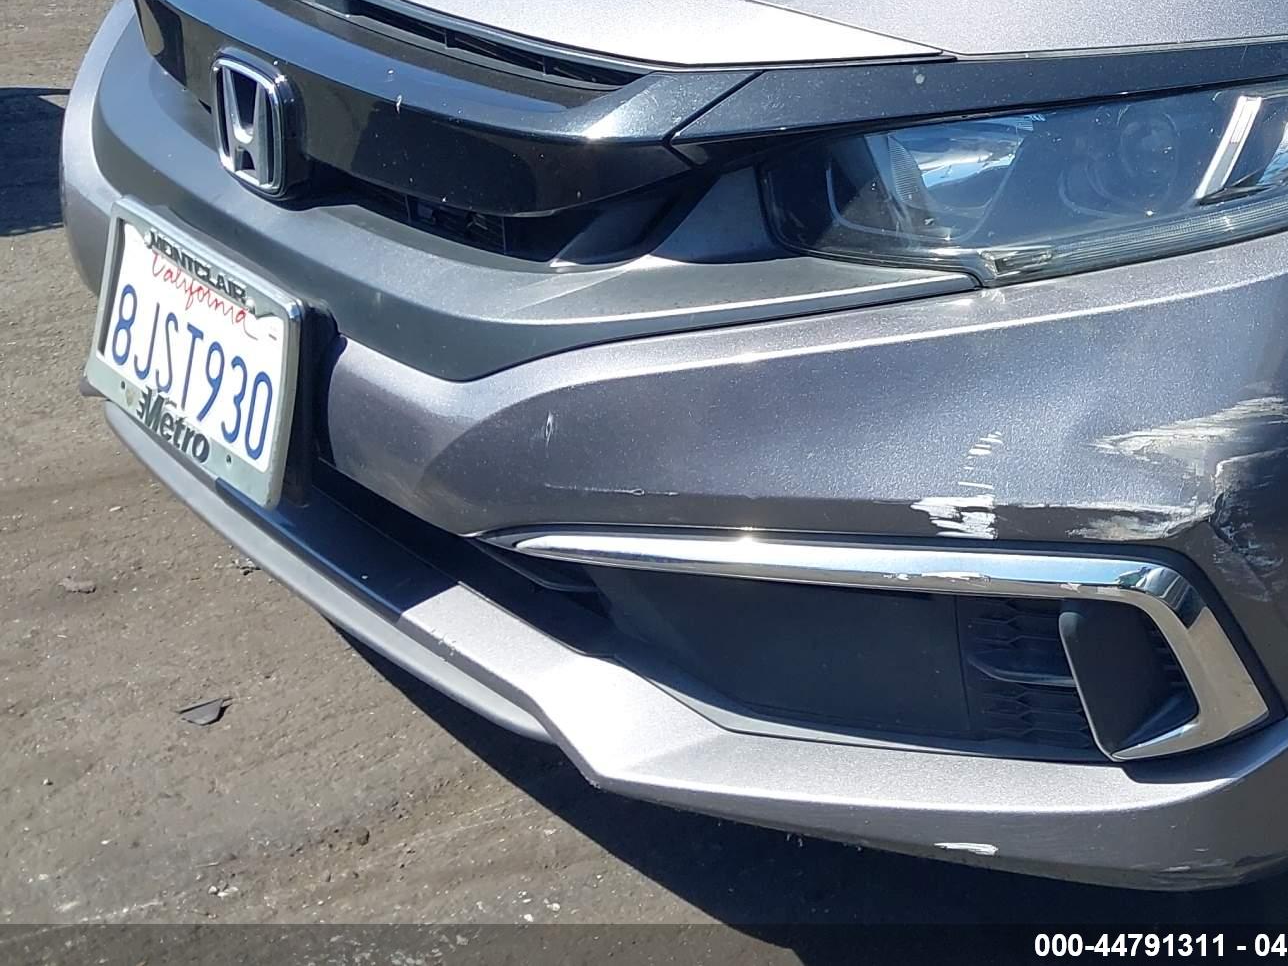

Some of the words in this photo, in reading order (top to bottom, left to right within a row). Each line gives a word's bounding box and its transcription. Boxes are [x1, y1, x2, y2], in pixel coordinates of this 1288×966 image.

[148, 230, 247, 307] MONTCLAIR
[152, 249, 258, 340] California
[112, 284, 272, 460] 8JST930
[136, 385, 210, 464] Metro
